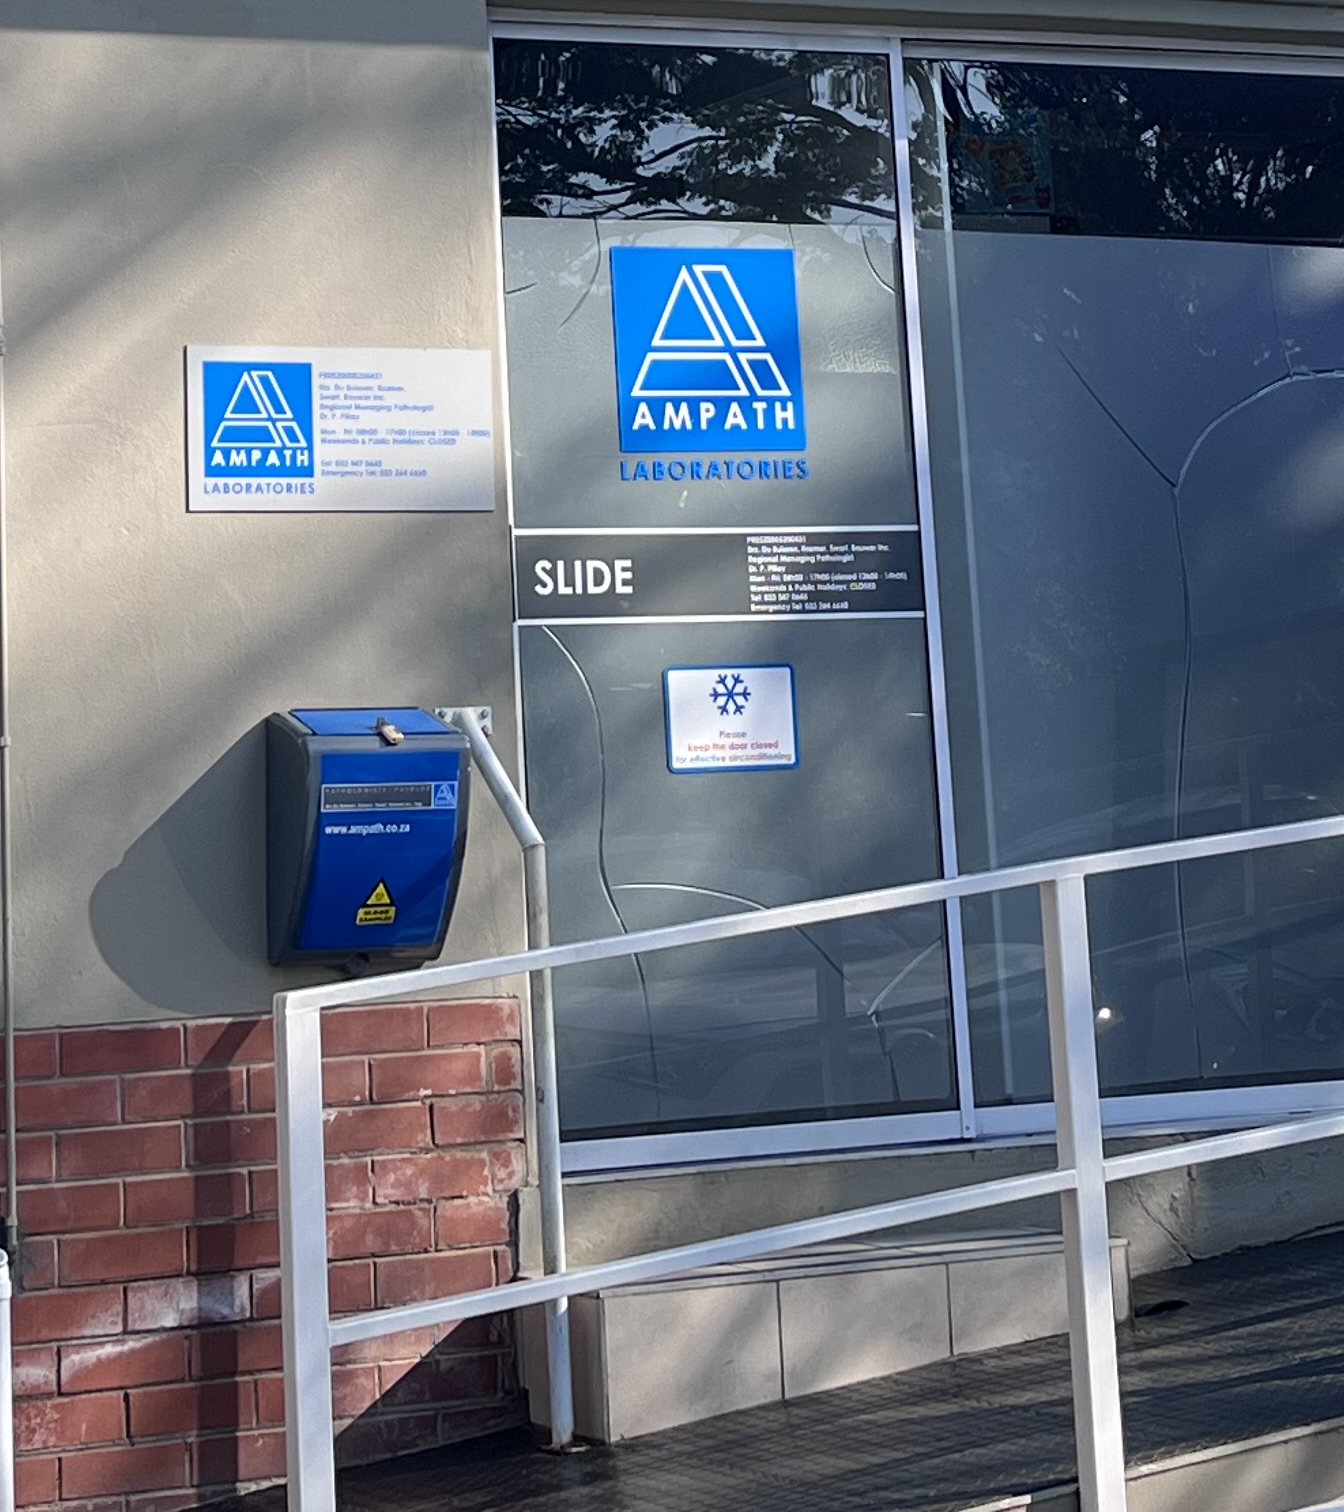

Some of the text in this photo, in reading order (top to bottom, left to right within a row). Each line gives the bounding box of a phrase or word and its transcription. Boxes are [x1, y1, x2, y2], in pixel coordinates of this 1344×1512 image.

[632, 401, 794, 430] AMPATH
[210, 449, 309, 467] AMPATH
[620, 459, 809, 481] LABORATORIES
[203, 482, 315, 495] LABORATORIES
[534, 559, 634, 596] SLIDE
[719, 731, 747, 739] Please
[688, 744, 711, 752] keep
[728, 741, 748, 750] door
[750, 740, 779, 750] closed
[325, 823, 410, 836] www.ampath.co.za
